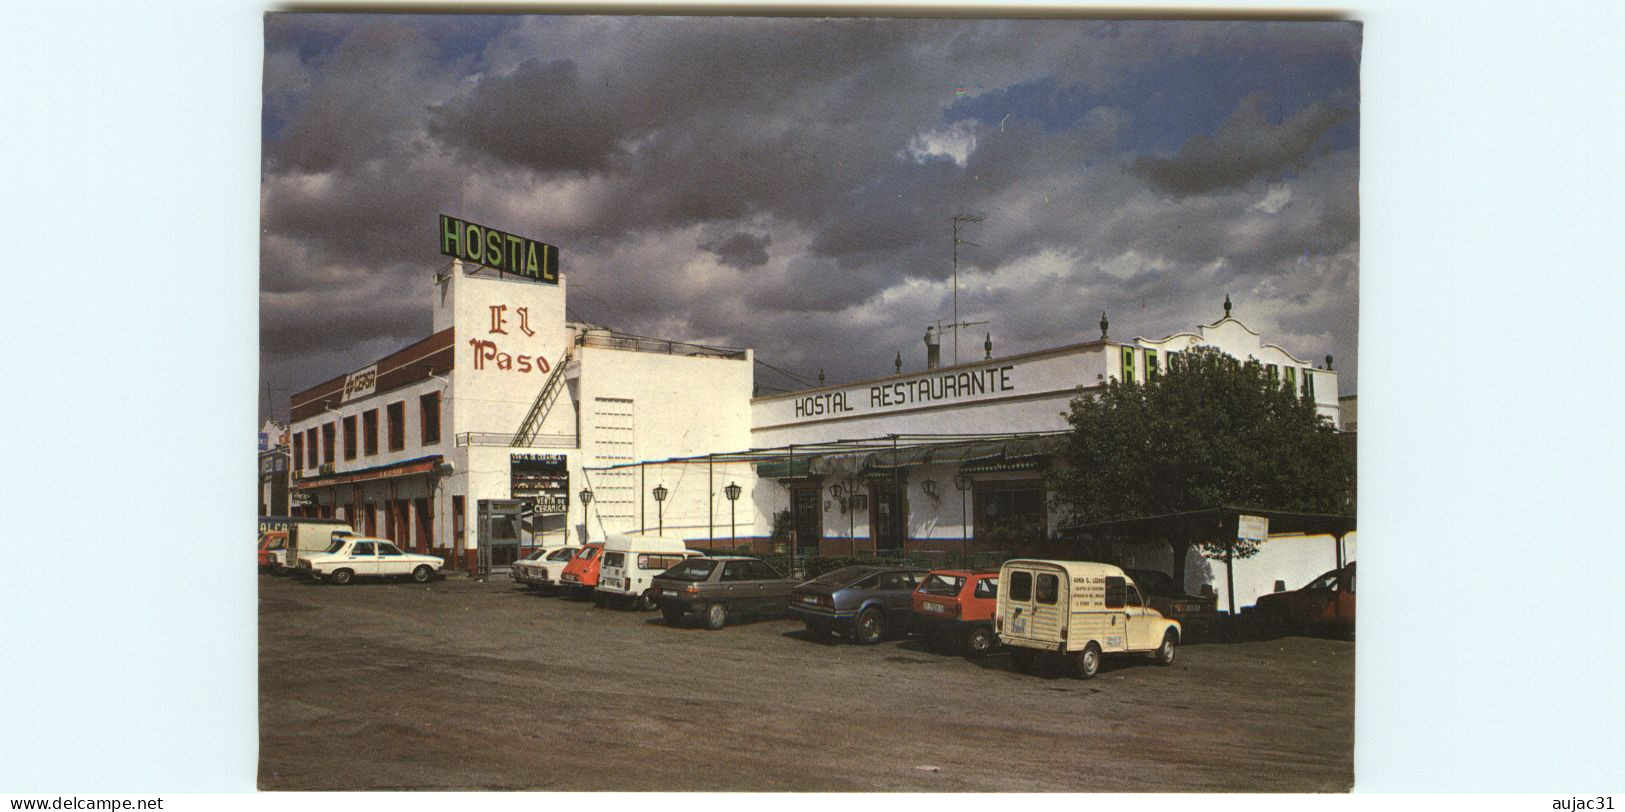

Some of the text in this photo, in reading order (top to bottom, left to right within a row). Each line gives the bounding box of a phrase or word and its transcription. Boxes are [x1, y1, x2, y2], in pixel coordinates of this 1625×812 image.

[443, 216, 554, 280] HOSTAL
[488, 304, 535, 337] El
[469, 338, 551, 374] Paso
[795, 366, 1014, 418] HOSTAL RESTAURANTE
[534, 504, 567, 513] CERAMICA
[536, 496, 556, 505] VENTA
